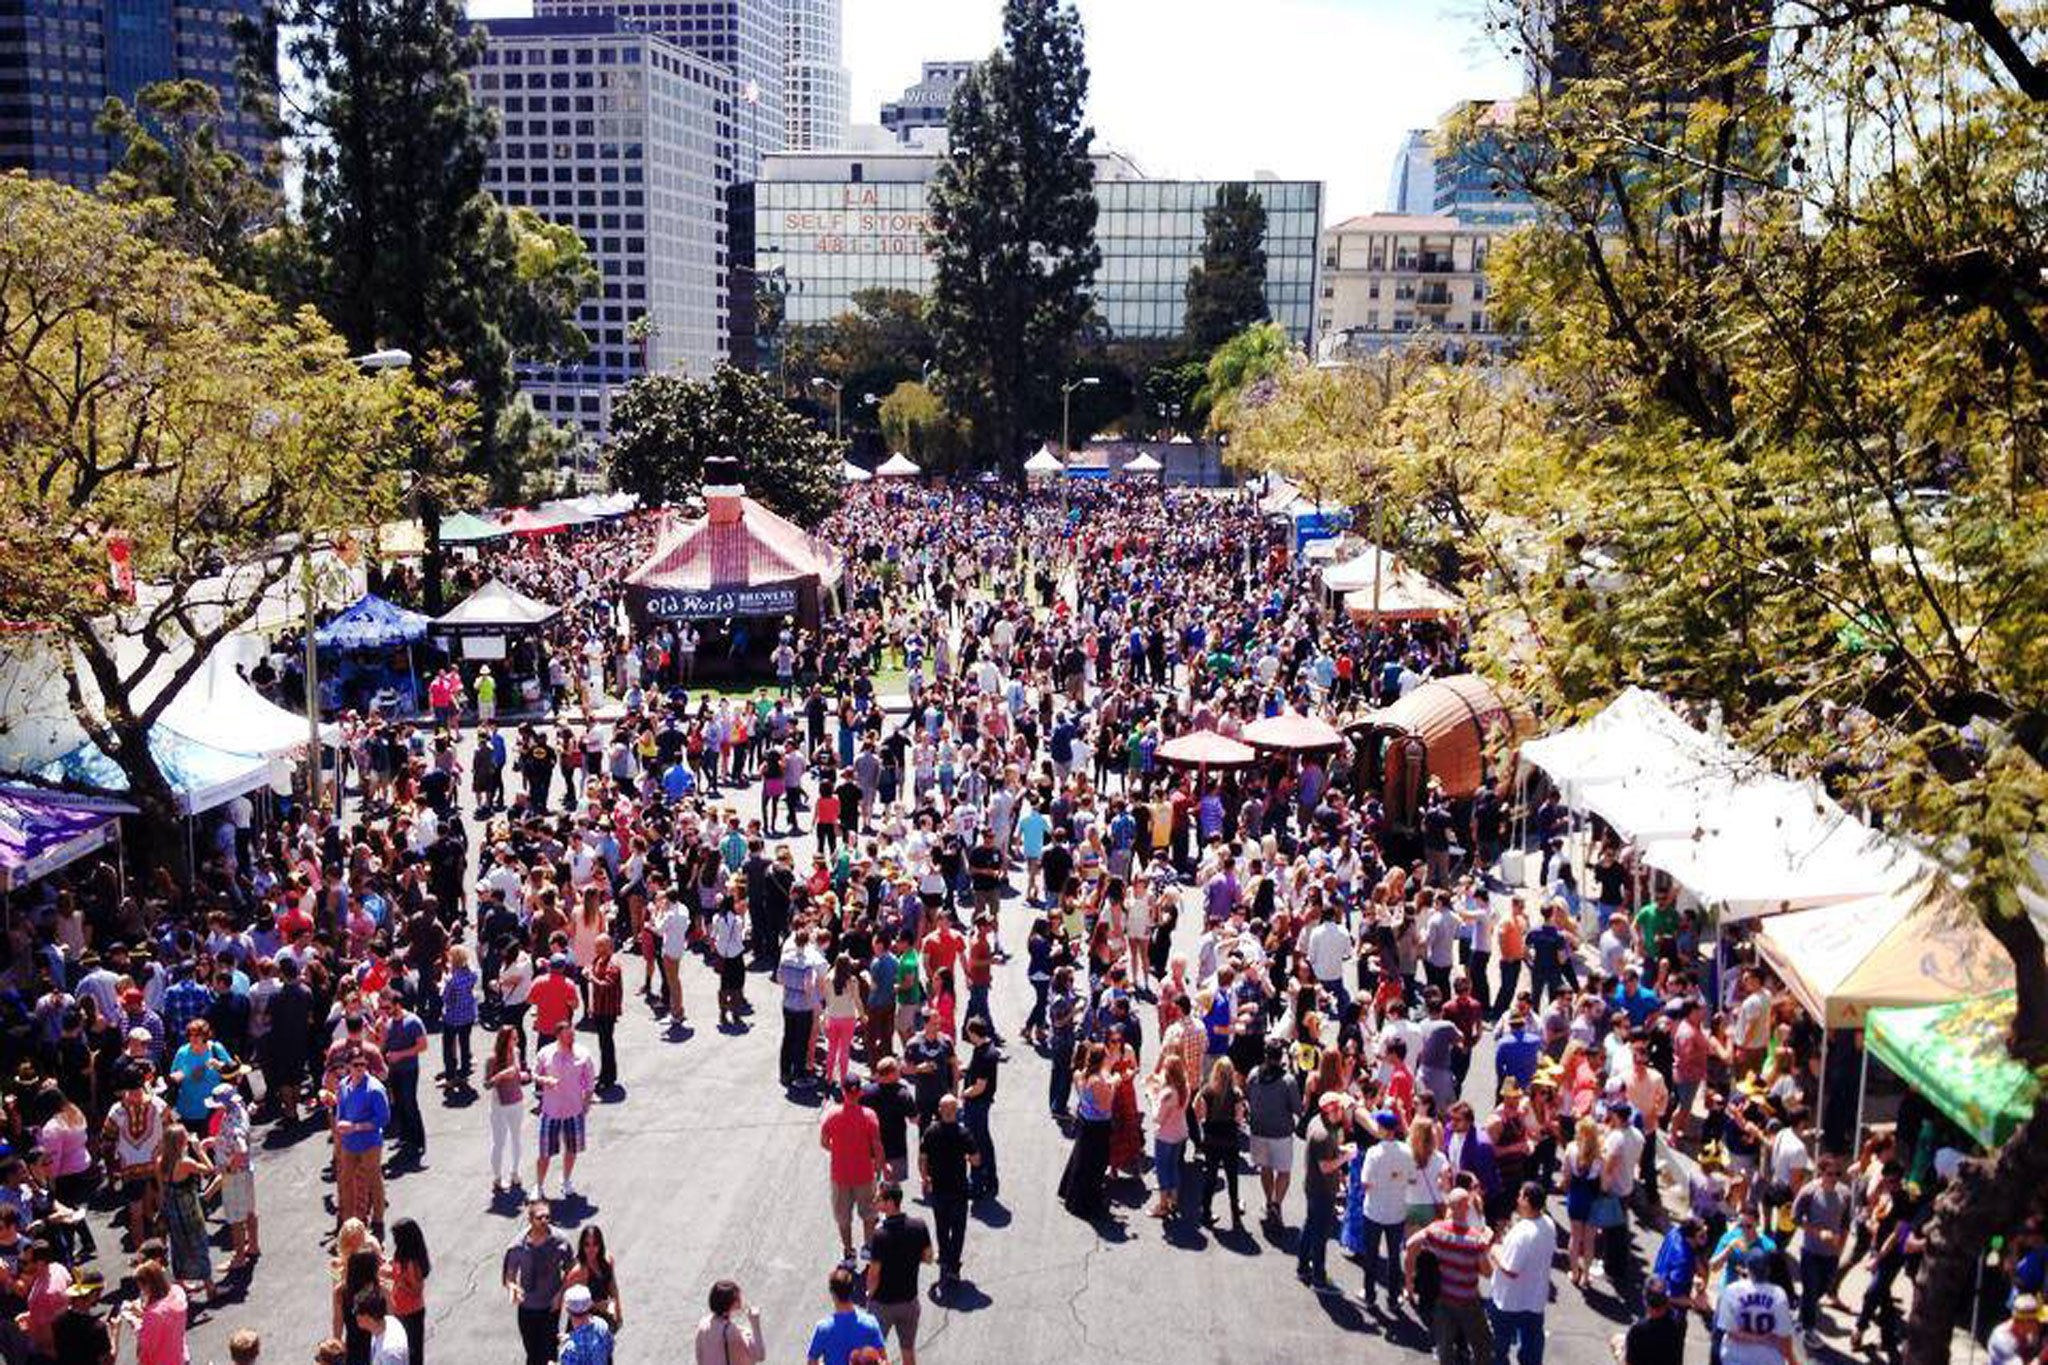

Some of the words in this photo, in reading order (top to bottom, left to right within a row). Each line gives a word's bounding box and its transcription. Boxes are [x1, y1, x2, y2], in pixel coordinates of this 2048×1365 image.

[843, 189, 878, 205] LA
[786, 213, 842, 230] SELF
[861, 214, 936, 231] STOR
[817, 237, 934, 255] 481-101
[646, 596, 679, 614] Old
[682, 592, 735, 614] World
[1739, 1312, 1776, 1335] 10
